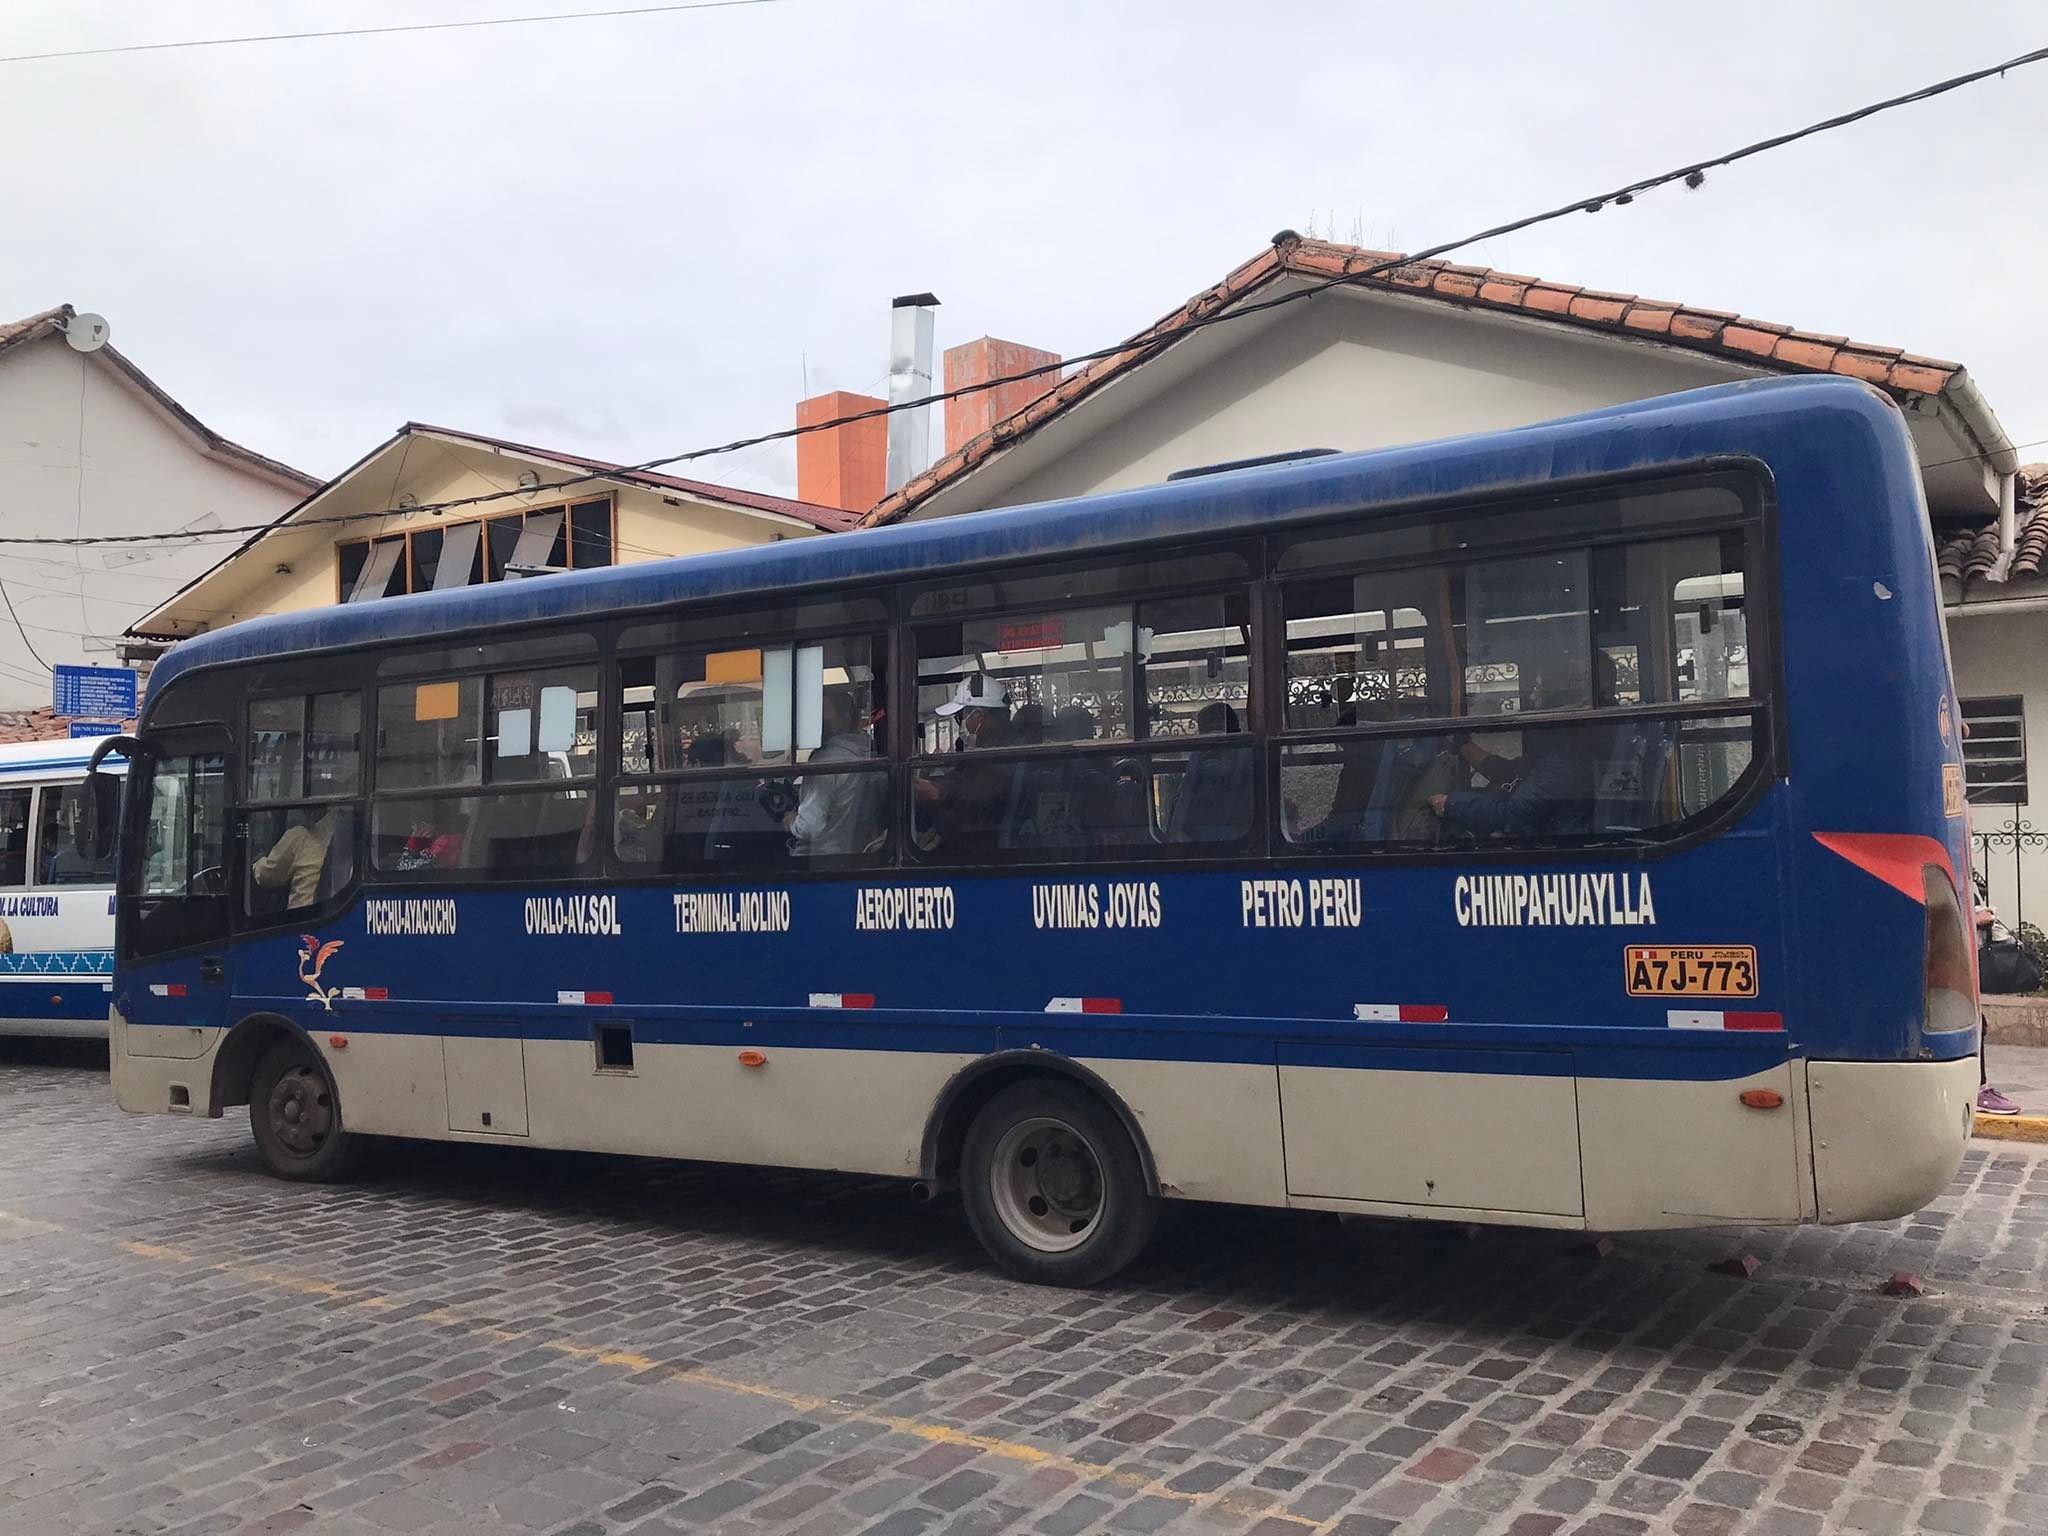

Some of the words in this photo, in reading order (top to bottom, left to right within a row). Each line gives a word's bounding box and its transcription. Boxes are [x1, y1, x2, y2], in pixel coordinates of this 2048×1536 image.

[7, 897, 19, 917] LA
[20, 896, 59, 917] CULTURA
[366, 899, 457, 935] PICCHU-AYACUCHO
[524, 894, 622, 935] OVALO-AV.SOL
[673, 890, 791, 933] TERMINAL-MOLINO
[855, 886, 955, 930] AEROPUERTO
[1032, 883, 1100, 929] UVIMAS
[1104, 881, 1162, 929] JOYAS
[1241, 879, 1304, 928] PETRO
[1309, 878, 1362, 928] PERU
[1454, 872, 1657, 927] CHIMPAHUAYLLA
[1631, 960, 1753, 992] A7J-773
[1670, 950, 1704, 960] PERU
